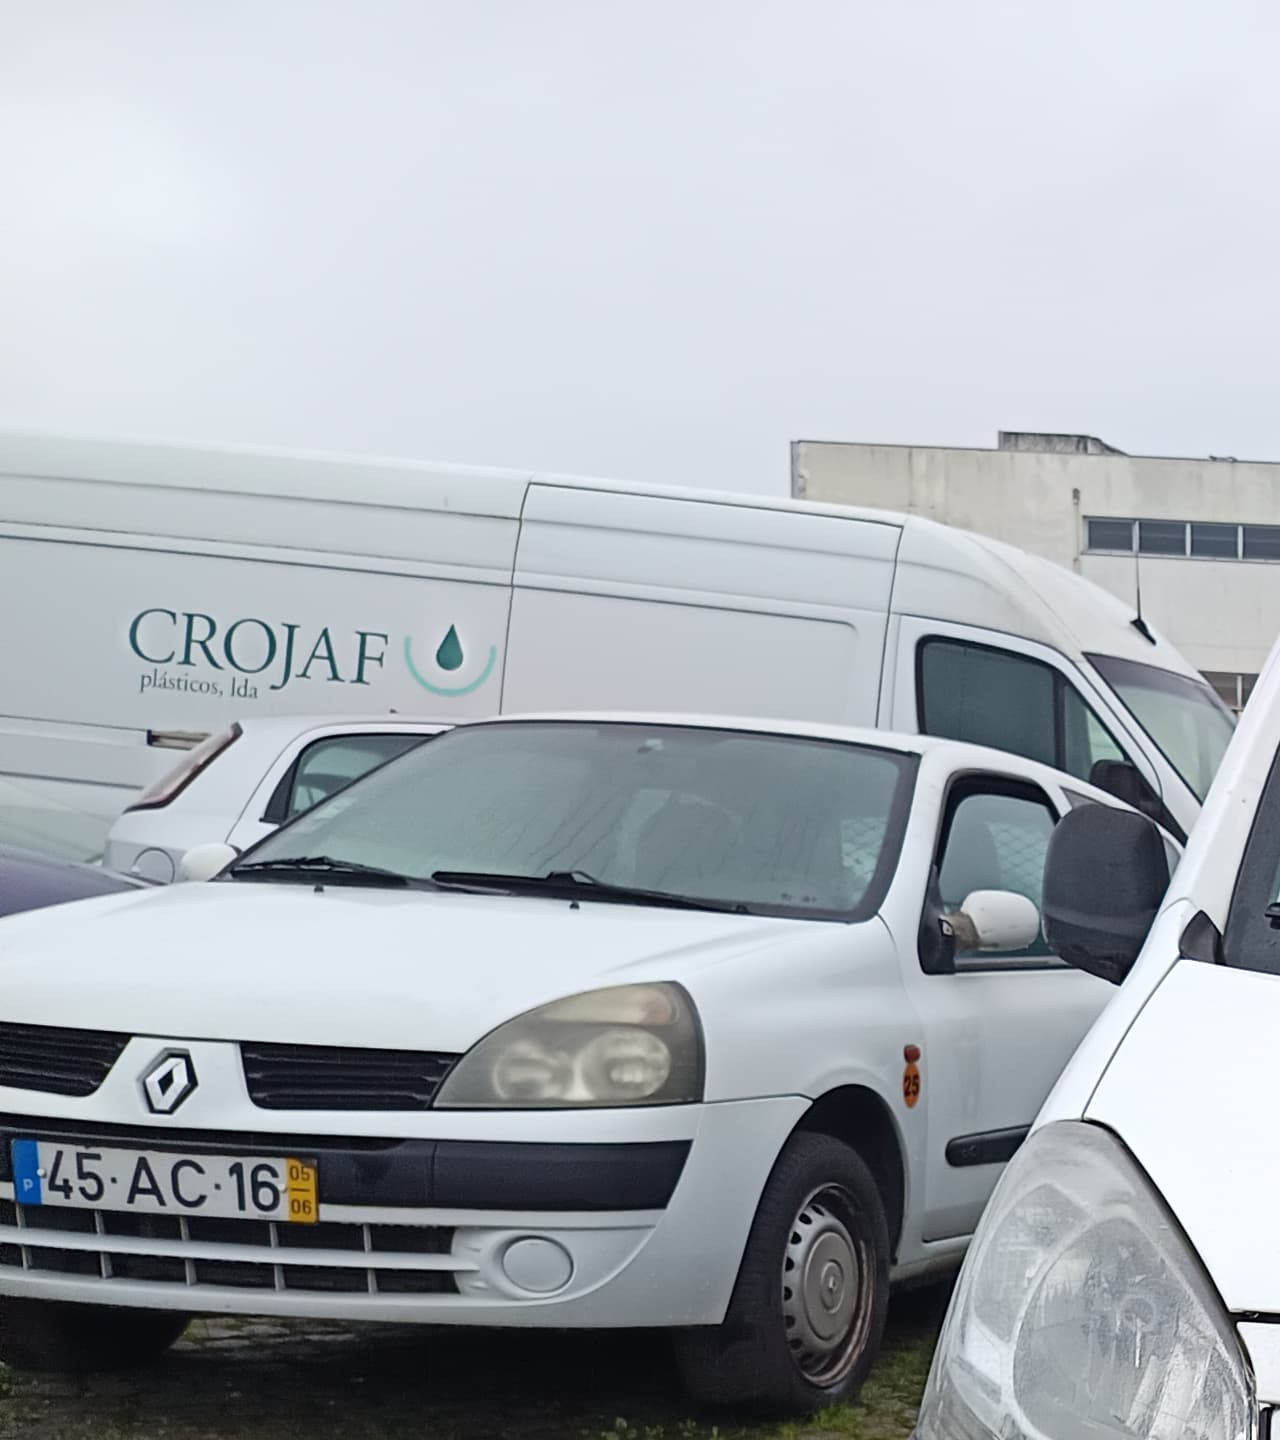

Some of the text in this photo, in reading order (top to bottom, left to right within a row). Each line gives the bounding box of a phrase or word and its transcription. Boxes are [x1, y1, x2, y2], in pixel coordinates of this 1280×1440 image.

[129, 608, 389, 691] CROJAF
[140, 669, 258, 699] plásticos, lda
[904, 1075, 920, 1097] 25
[289, 1165, 311, 1181] 05
[23, 1178, 34, 1192] P
[291, 1199, 312, 1215] 06
